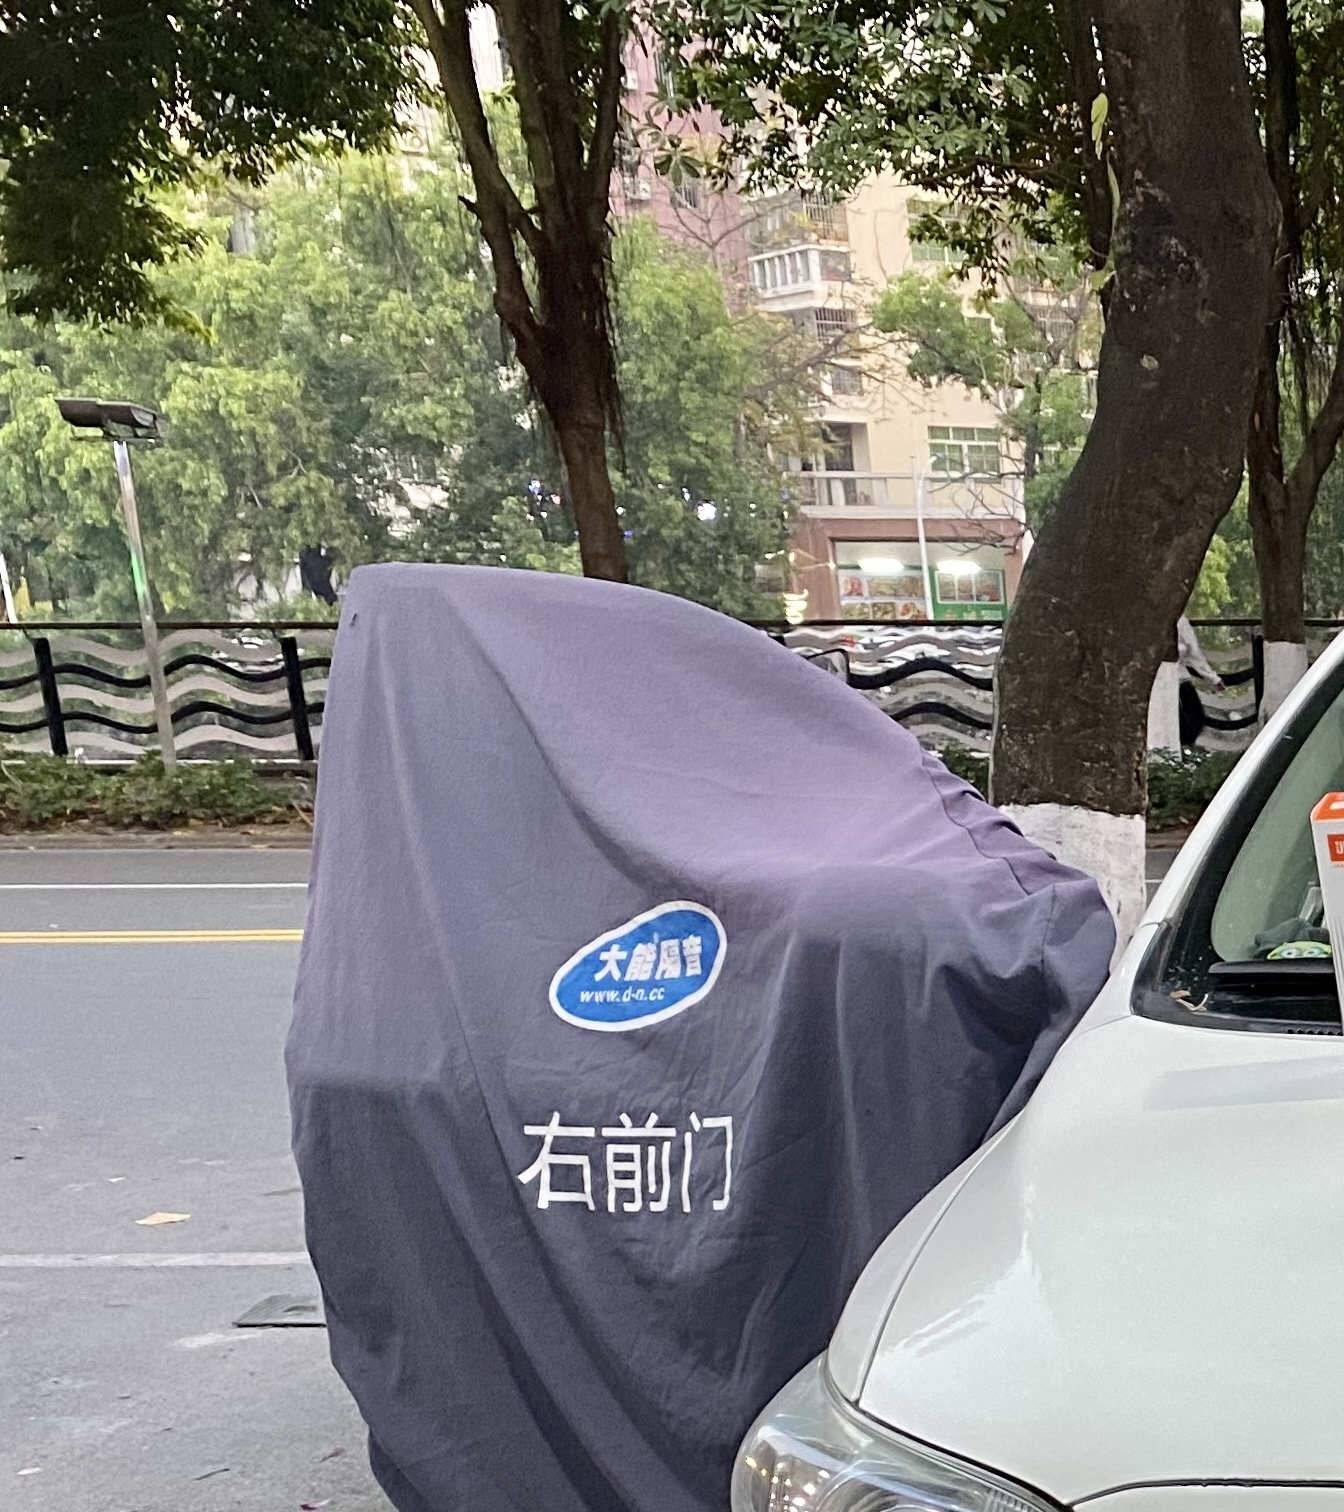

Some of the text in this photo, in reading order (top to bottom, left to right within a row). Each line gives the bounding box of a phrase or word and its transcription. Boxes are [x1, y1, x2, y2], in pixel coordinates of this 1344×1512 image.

[579, 985, 665, 1003] www.d-n.cc
[517, 1111, 734, 1213] 右前门
